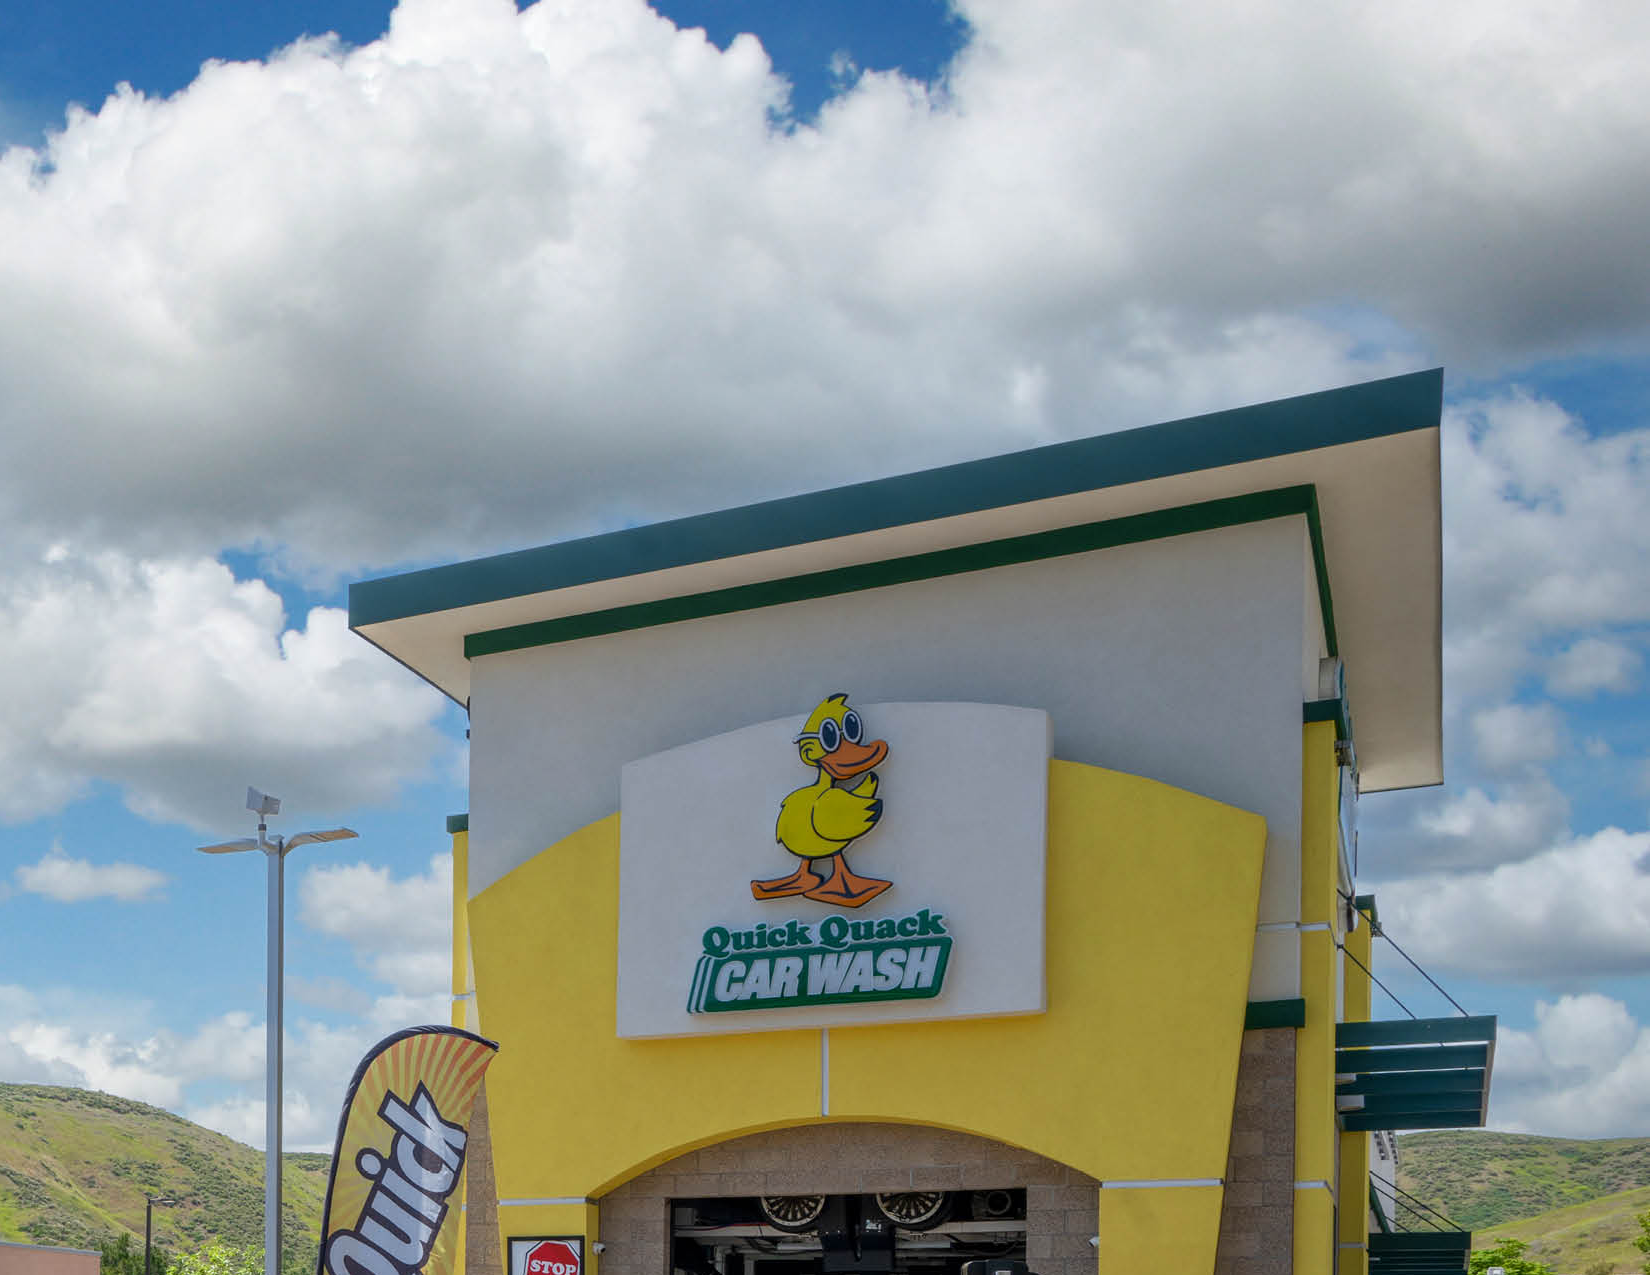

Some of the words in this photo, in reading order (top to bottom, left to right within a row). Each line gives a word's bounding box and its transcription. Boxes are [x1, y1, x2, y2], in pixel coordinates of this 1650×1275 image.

[702, 920, 813, 957] Quick
[819, 909, 946, 948] Quack
[714, 956, 804, 1002] CAR
[807, 945, 942, 995] WASH
